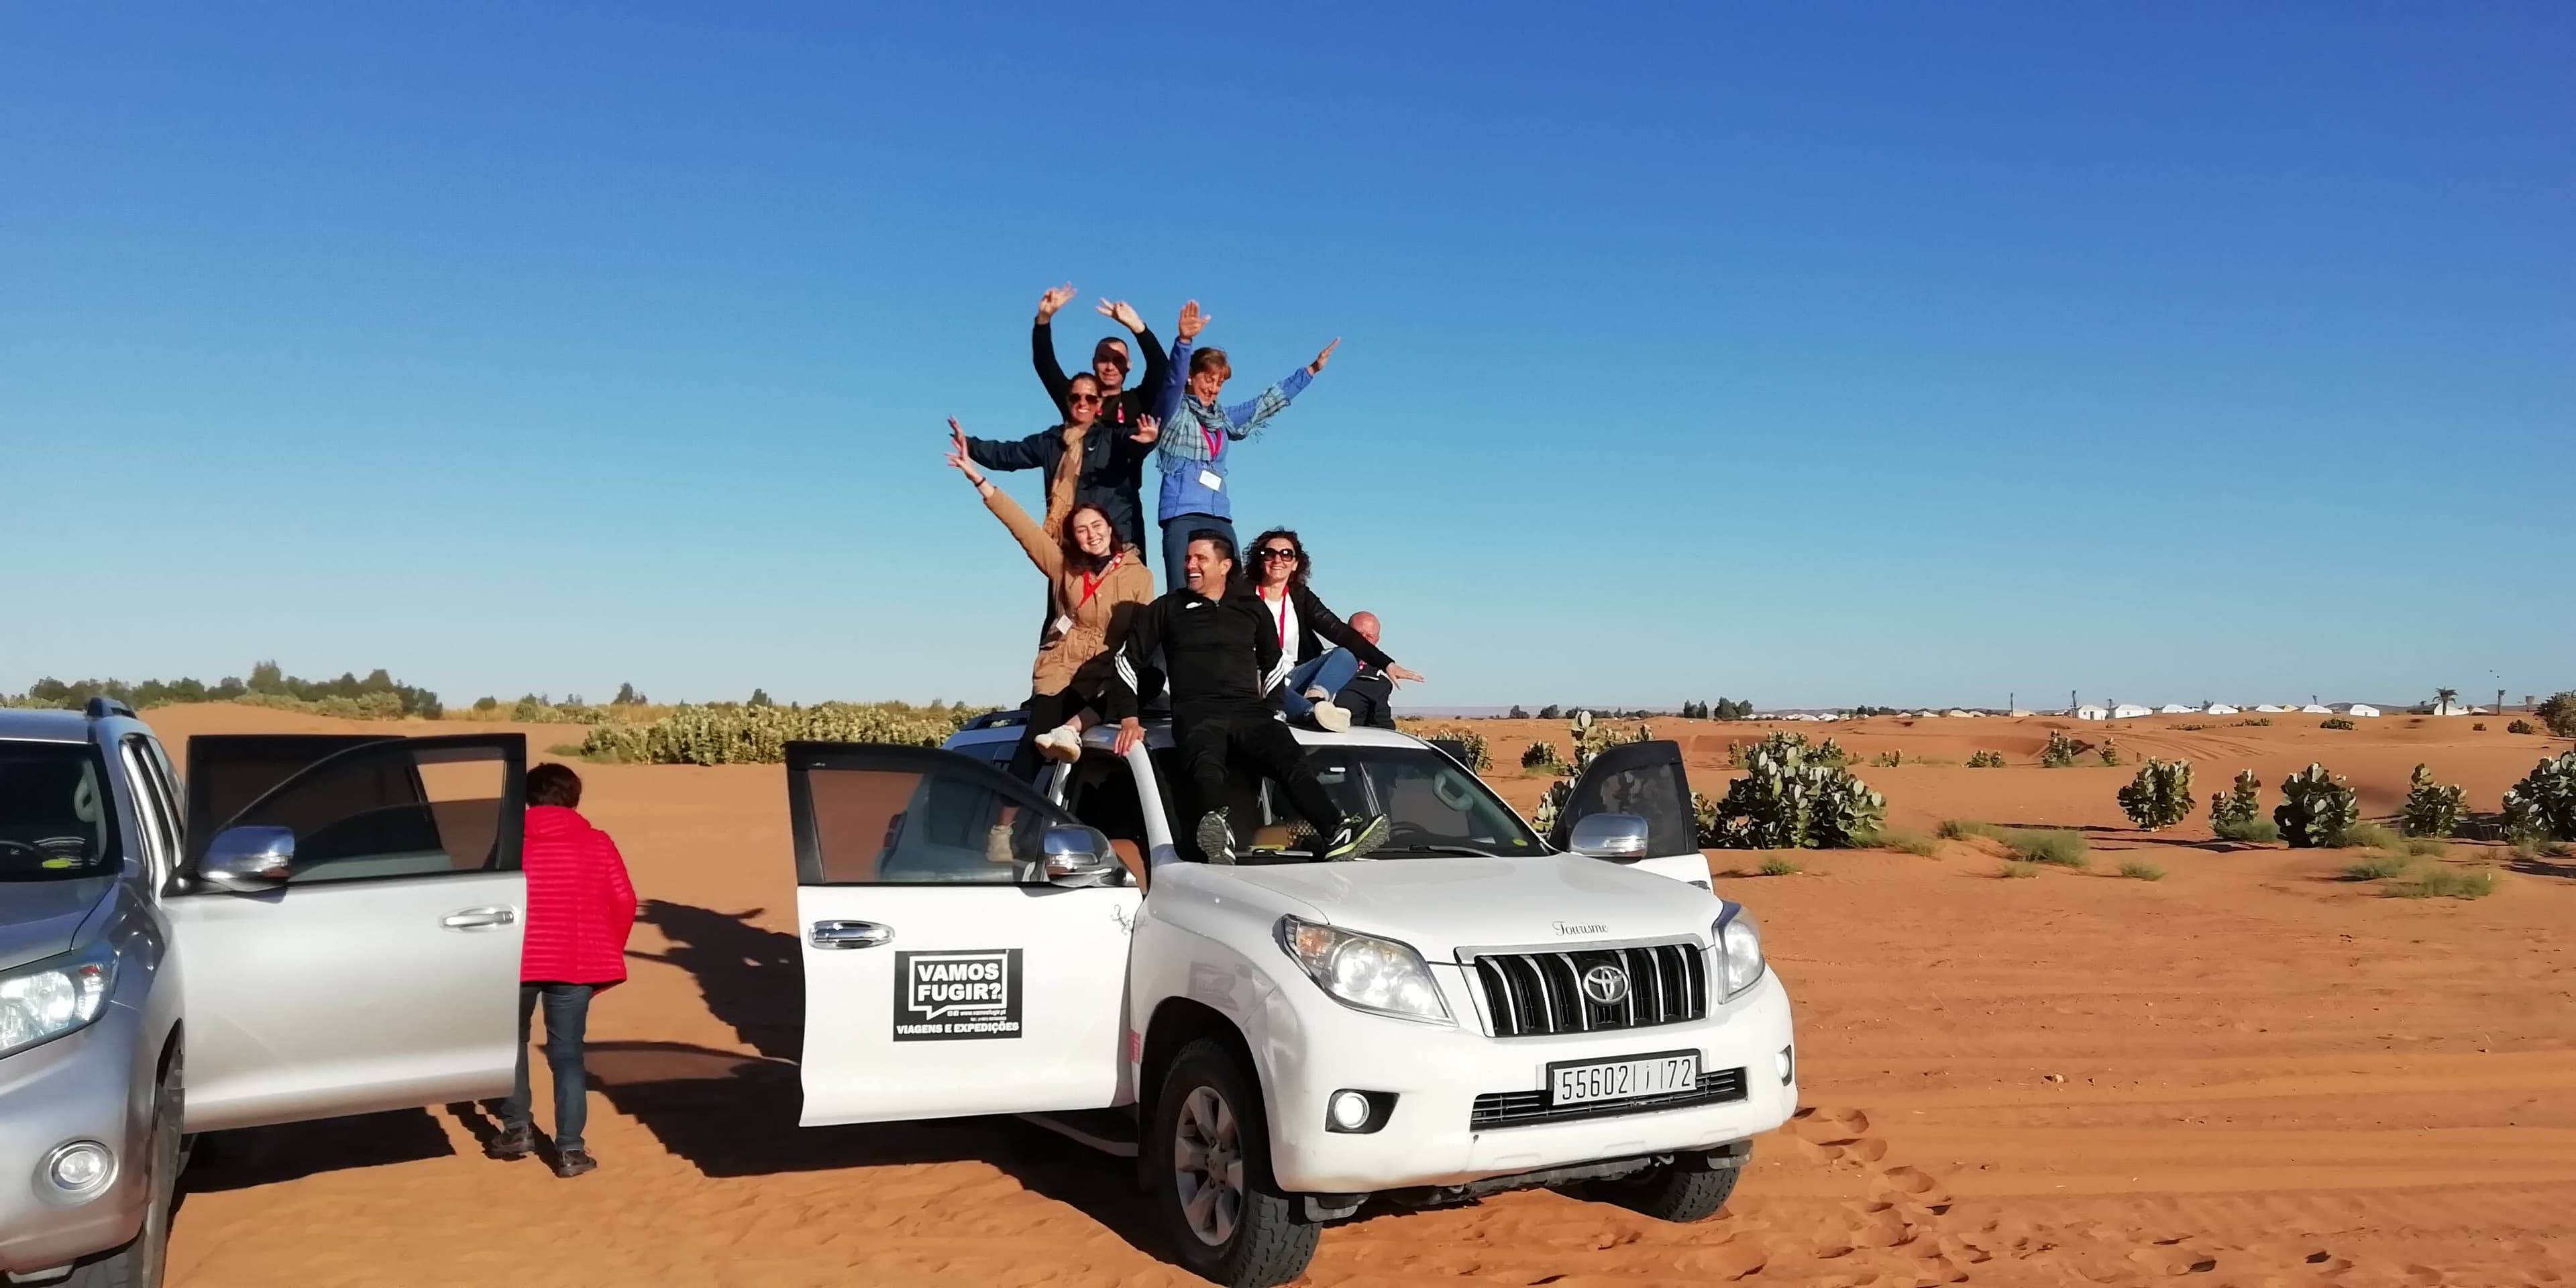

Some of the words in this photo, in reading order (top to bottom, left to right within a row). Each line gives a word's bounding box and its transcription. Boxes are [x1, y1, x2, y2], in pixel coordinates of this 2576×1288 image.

[1552, 921, 1609, 936] Tourisme
[917, 963, 1000, 981] VAMOS
[918, 982, 1001, 1002] FUGIR?
[896, 1024, 943, 1034] VIAGENS
[945, 1024, 952, 1033] E
[954, 1021, 1019, 1034] EXPEDIÇÕES
[1562, 1065, 1628, 1100] 55602
[1668, 1059, 1691, 1088] 72
